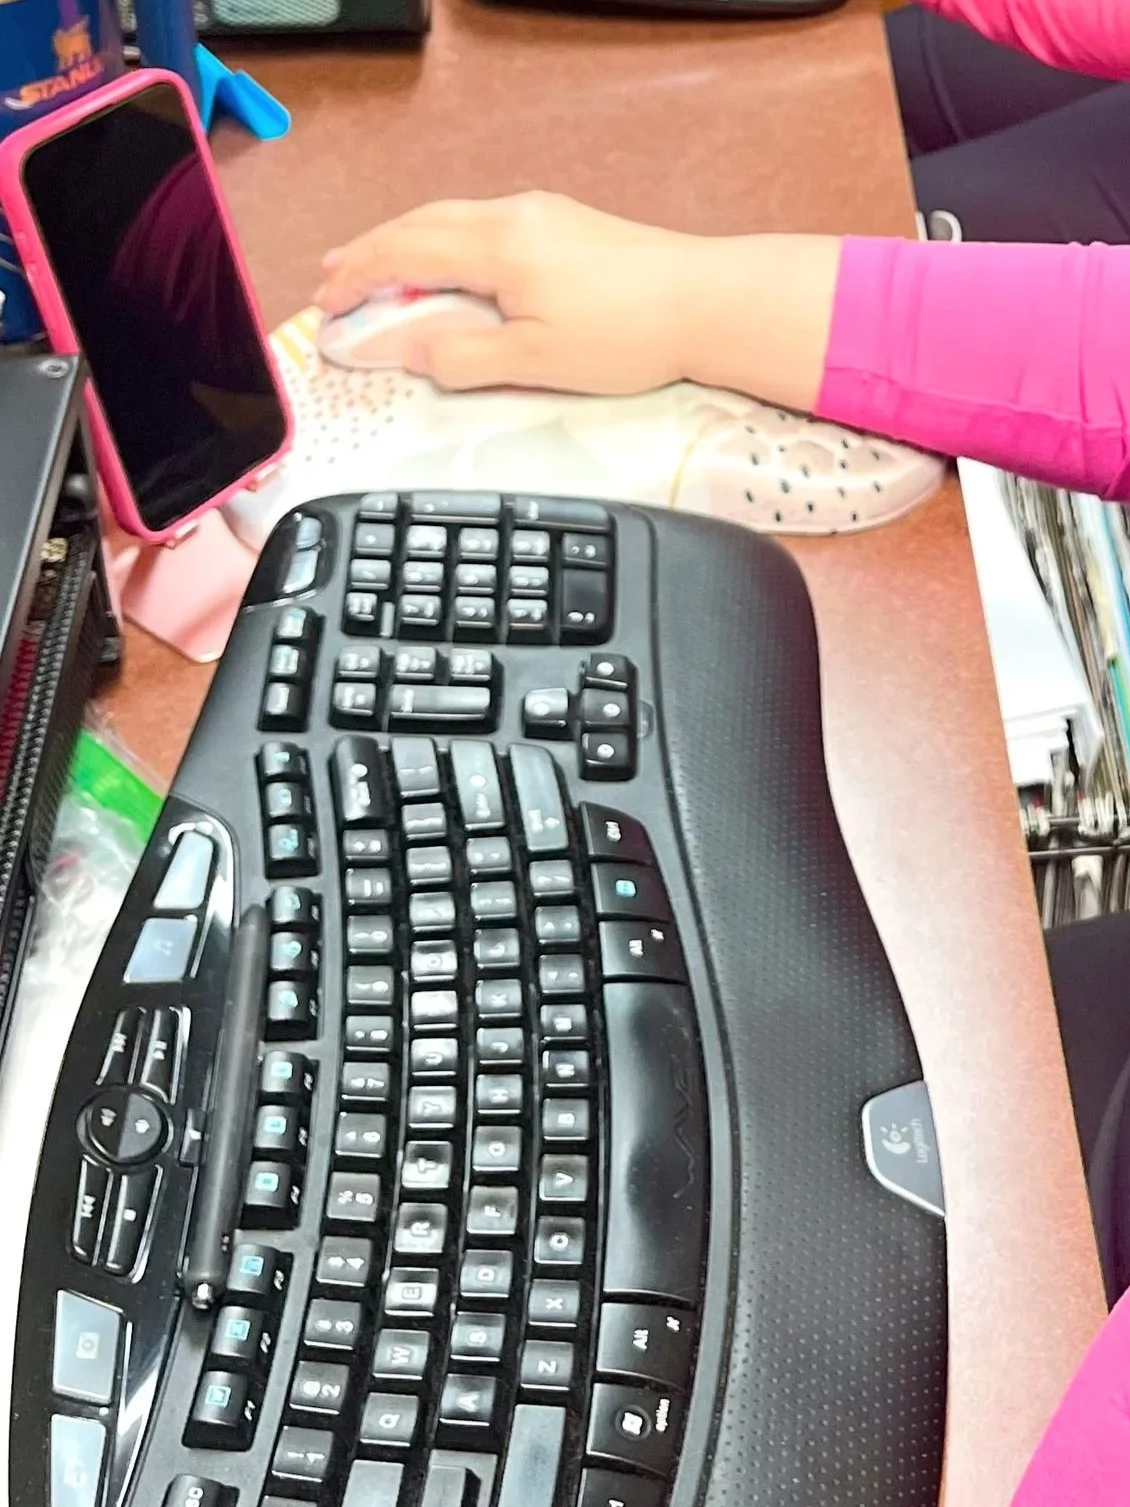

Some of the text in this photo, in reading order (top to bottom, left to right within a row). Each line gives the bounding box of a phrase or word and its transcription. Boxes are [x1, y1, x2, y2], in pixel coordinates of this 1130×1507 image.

[488, 942, 505, 956] L
[489, 994, 507, 1007] K
[490, 1041, 508, 1053] J
[423, 1052, 443, 1066] U
[556, 1063, 575, 1077] N
[366, 1077, 384, 1088] 7
[489, 1088, 508, 1102] H
[558, 1113, 575, 1127] B
[909, 1117, 930, 1164] Logitech
[417, 1158, 438, 1174] T
[554, 1172, 573, 1186] V
[485, 1205, 501, 1217] F
[410, 1221, 430, 1236] R
[551, 1233, 569, 1248] C
[477, 1268, 495, 1281] D
[402, 1286, 421, 1300] E
[546, 1297, 563, 1309] X
[632, 1329, 649, 1349] Alt
[390, 1347, 410, 1365] W
[538, 1360, 557, 1374] Z
[322, 1384, 341, 1398] 2
[459, 1395, 477, 1408] A
[378, 1413, 393, 1429] Q
[654, 1398, 671, 1432] option
